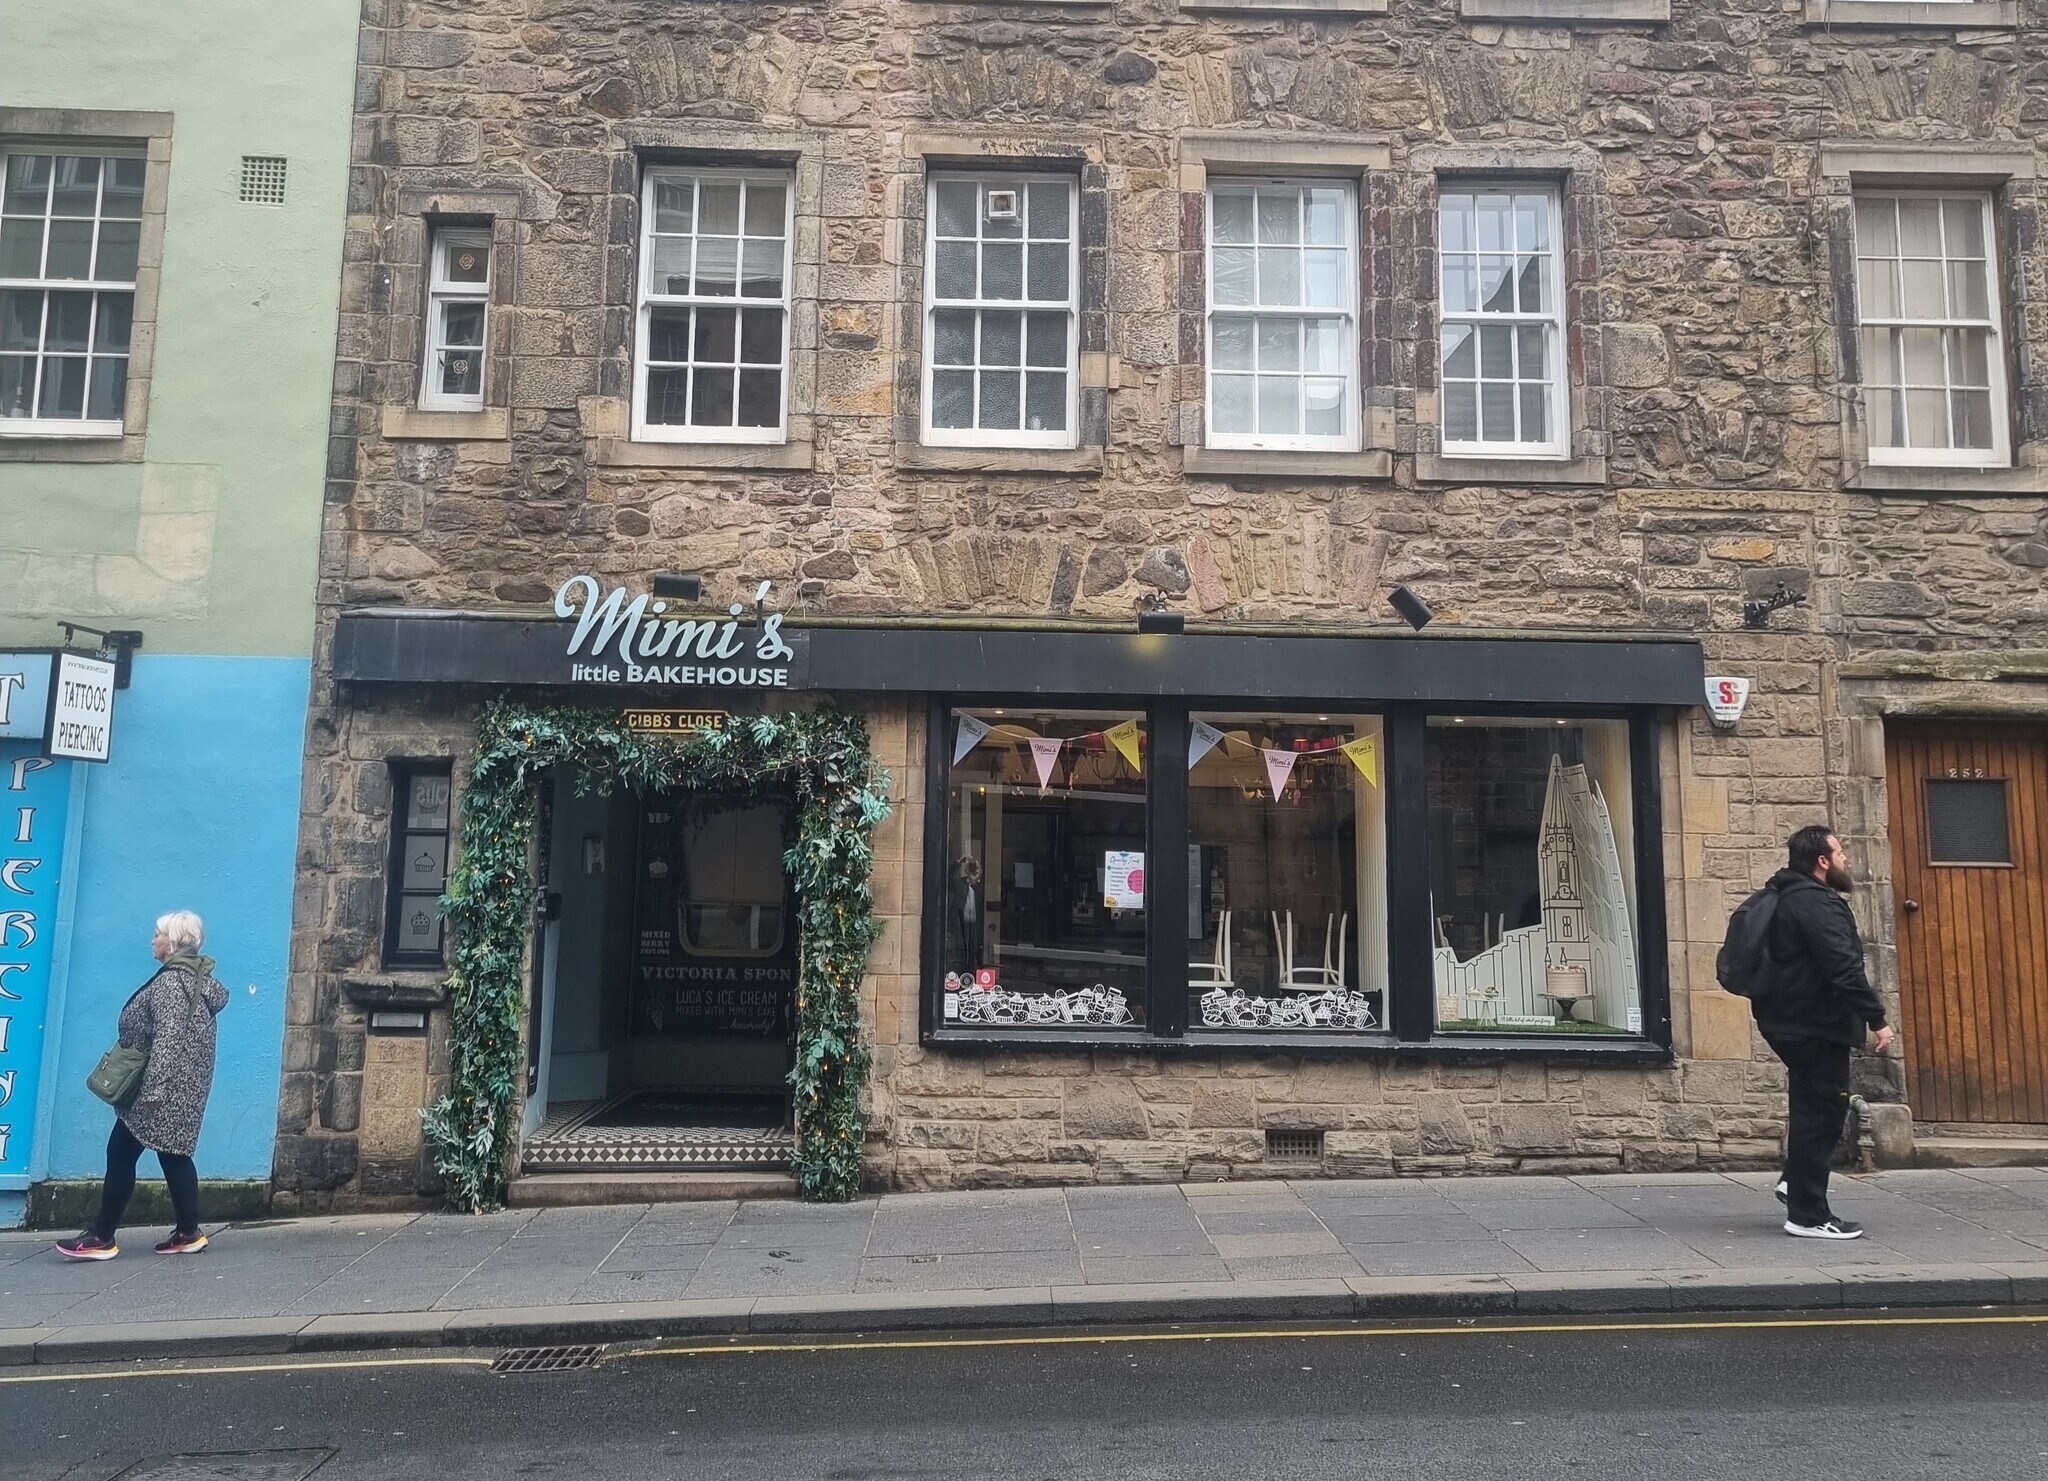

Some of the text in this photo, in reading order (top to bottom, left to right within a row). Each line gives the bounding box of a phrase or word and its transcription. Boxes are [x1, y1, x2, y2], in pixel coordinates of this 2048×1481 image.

[554, 575, 794, 665] Mimi's
[571, 664, 788, 686] little BAKEHOUSE
[64, 681, 107, 713] TATTOOS
[628, 713, 723, 728] GIBB'S CLOSE
[962, 719, 983, 736] Mimi's
[58, 721, 104, 753] PIERCING
[1112, 727, 1135, 740] Mimi's
[1196, 726, 1216, 742] Mimi's
[1034, 744, 1057, 754] Mimi's
[1350, 743, 1372, 755] Mimi's
[1268, 756, 1292, 766] Mimi's
[1949, 768, 1984, 778] 252
[641, 931, 670, 939] MIXED
[641, 940, 670, 948] BERRY
[0, 757, 55, 1162] PIERCI
[641, 967, 738, 981] VICTORIA
[676, 990, 777, 1005] LUCA'S ICE CREAM
[675, 1006, 701, 1016] MIXED
[704, 1007, 724, 1016] WITH
[757, 1007, 777, 1017] CAKE
